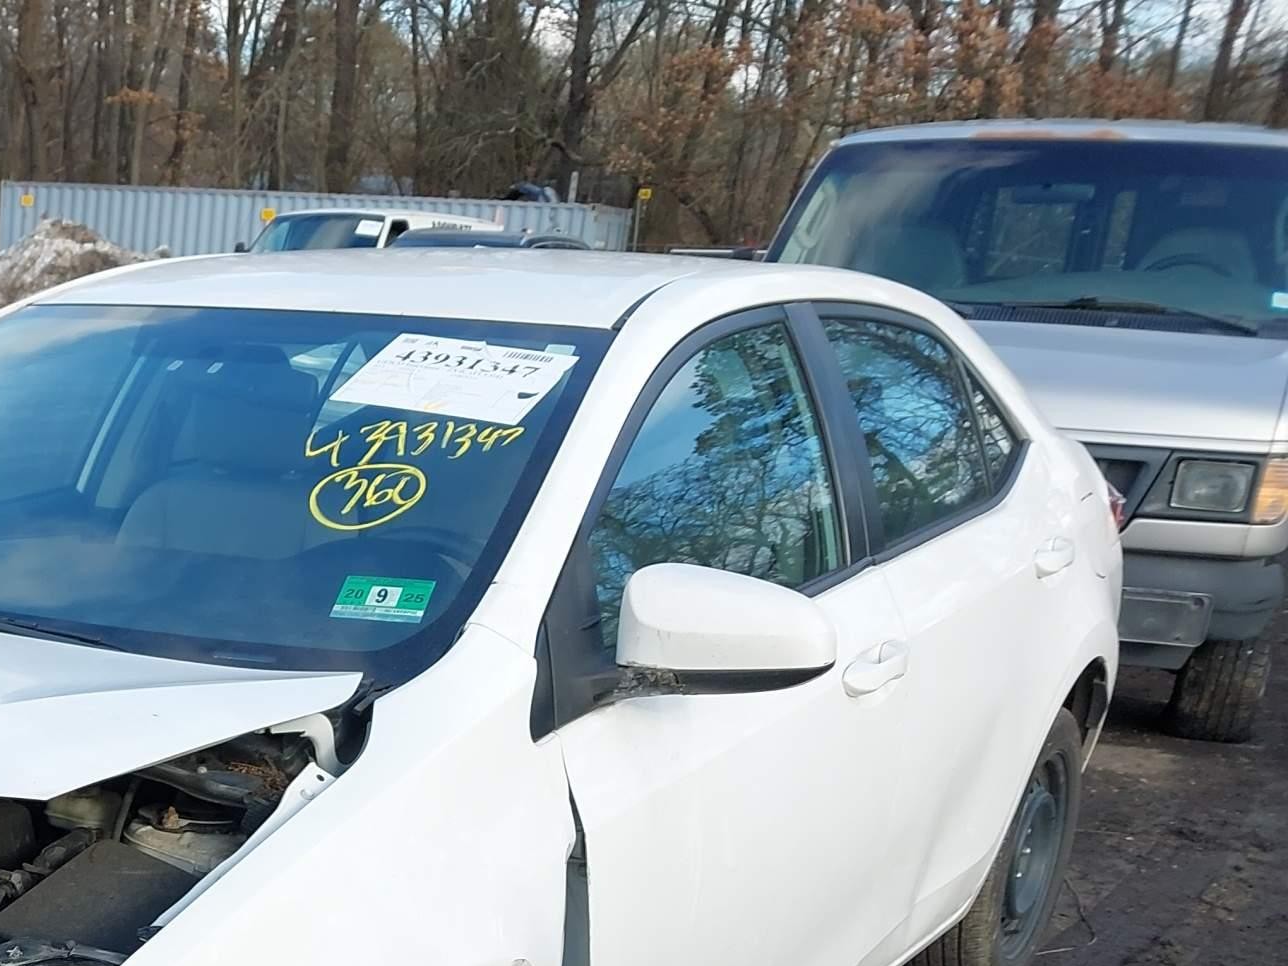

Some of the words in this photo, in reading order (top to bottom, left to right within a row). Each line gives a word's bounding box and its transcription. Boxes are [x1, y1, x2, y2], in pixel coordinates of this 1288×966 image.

[396, 349, 541, 378] 43931347
[333, 469, 418, 515] 360
[343, 588, 364, 599] 20
[375, 588, 389, 604] 9
[402, 592, 425, 604] 25
